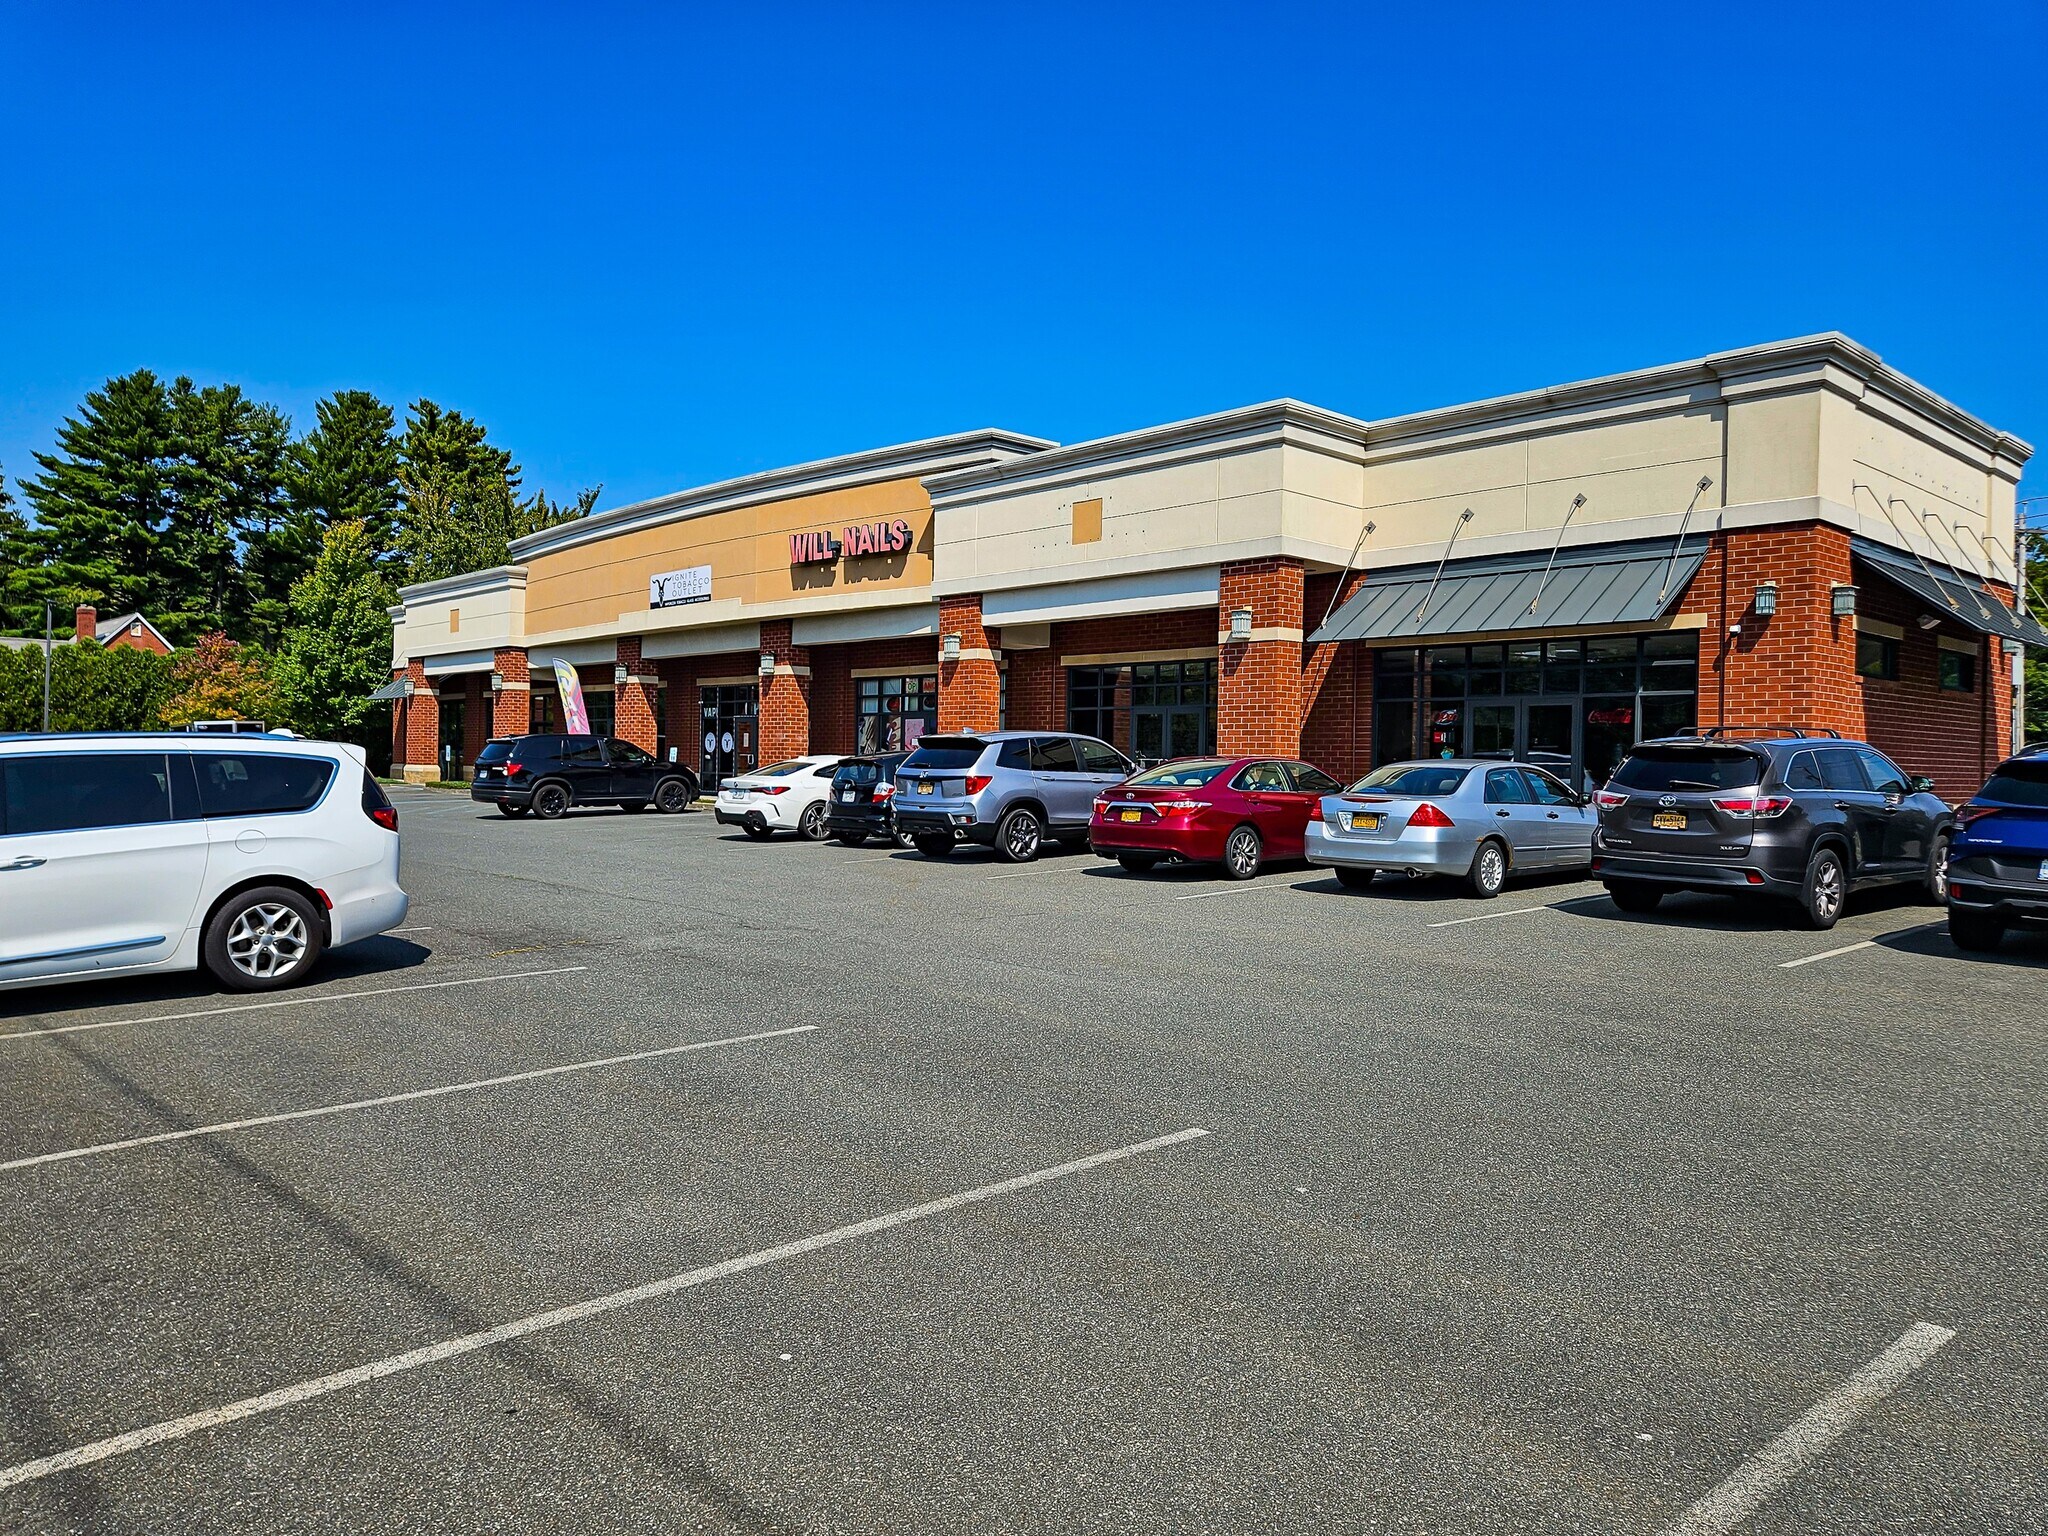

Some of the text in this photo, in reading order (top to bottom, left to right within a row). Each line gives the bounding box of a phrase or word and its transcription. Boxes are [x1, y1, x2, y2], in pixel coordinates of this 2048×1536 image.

[789, 519, 908, 564] WILL NAILS
[672, 571, 697, 582] IGNITE
[672, 577, 710, 589] TOBACCO
[672, 586, 702, 597] OUTLET
